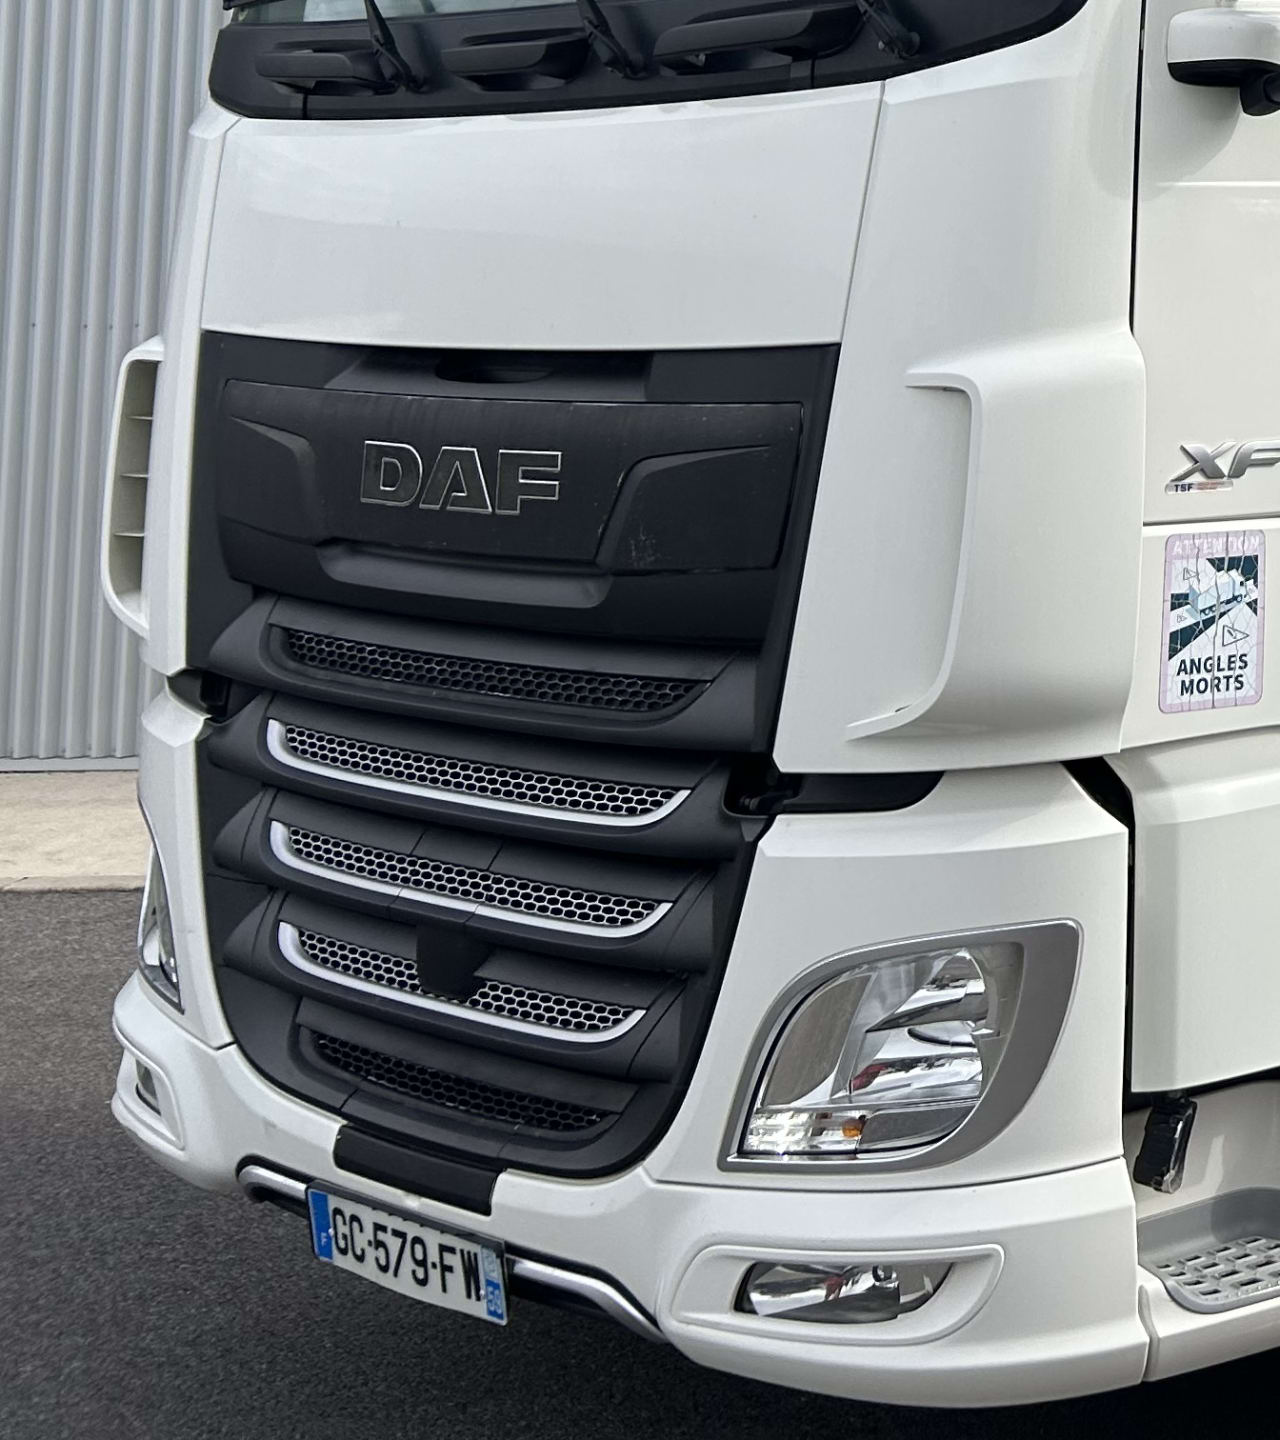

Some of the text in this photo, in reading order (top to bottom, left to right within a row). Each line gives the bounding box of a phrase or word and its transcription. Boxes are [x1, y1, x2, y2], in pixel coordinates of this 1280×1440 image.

[360, 440, 563, 516] DAF
[1172, 535, 1260, 556] ATTENTION
[1176, 652, 1249, 677] ANGLES
[1180, 674, 1245, 697] MORTS
[331, 1206, 482, 1303] GC-579-FW
